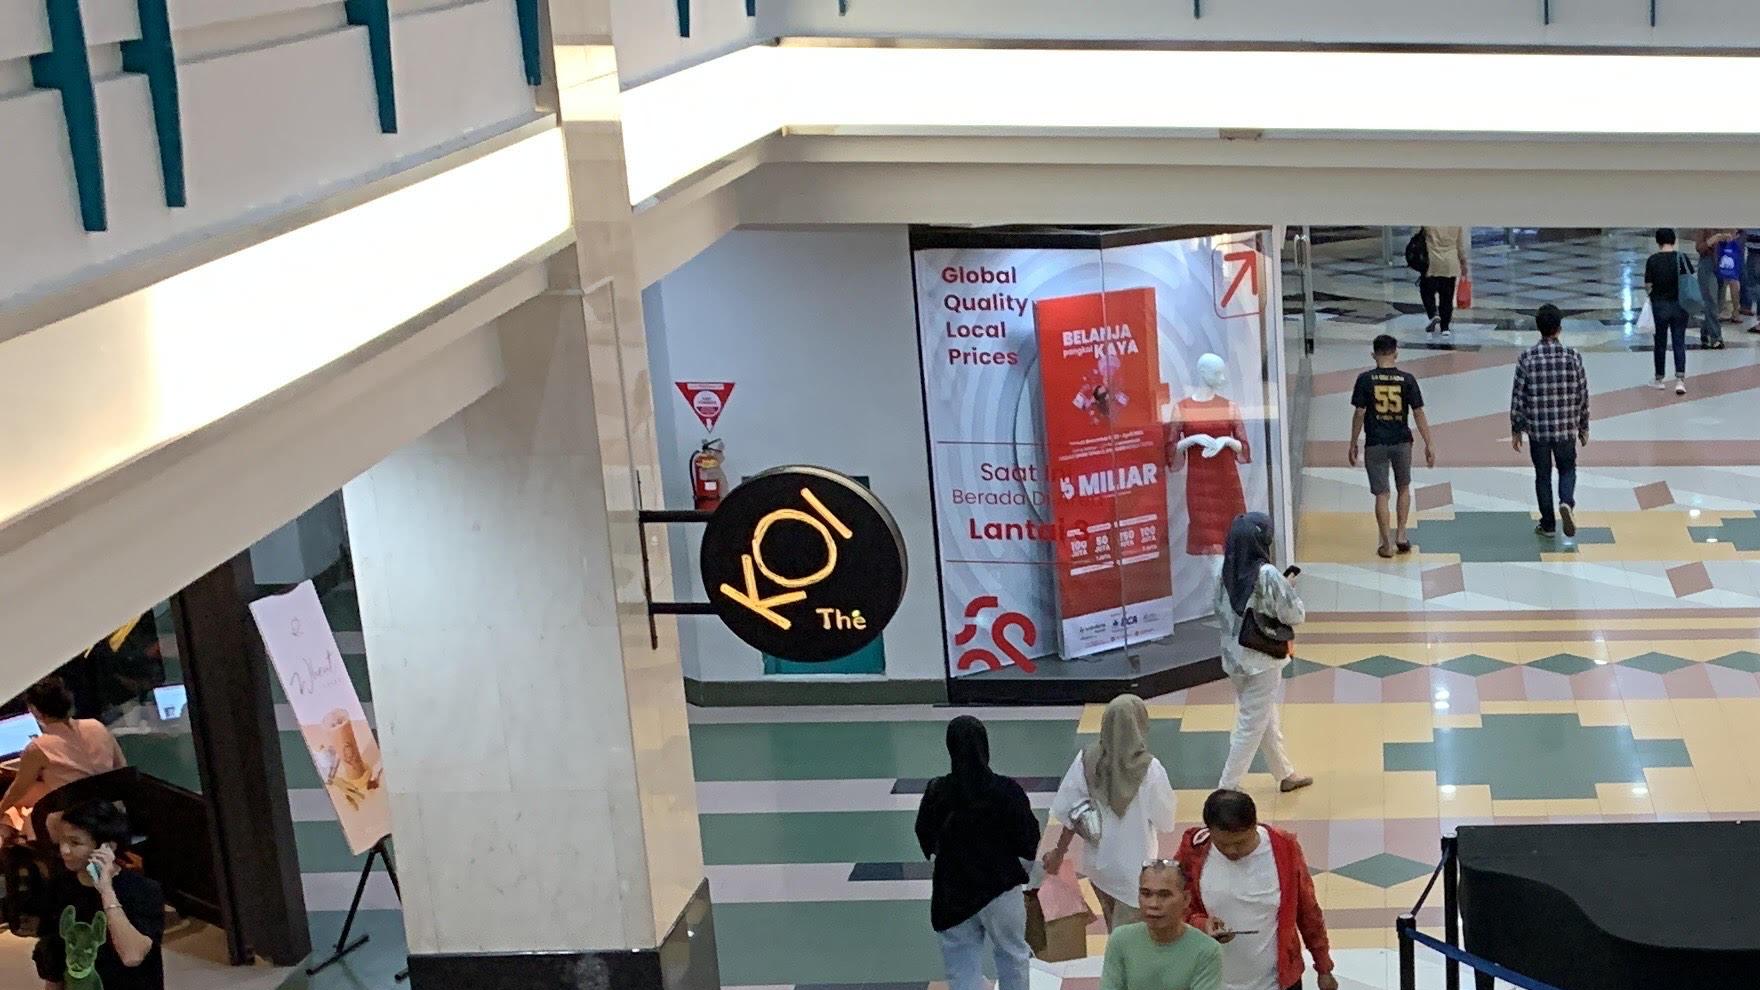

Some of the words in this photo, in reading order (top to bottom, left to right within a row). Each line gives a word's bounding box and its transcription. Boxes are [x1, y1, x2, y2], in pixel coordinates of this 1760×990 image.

[941, 266, 1016, 284] Global
[943, 293, 1028, 317] Quality
[946, 321, 1006, 338] Local
[1062, 324, 1132, 346] BELANJA
[948, 347, 1018, 365] Prices
[1094, 339, 1139, 359] KAYA
[1374, 384, 1402, 413] 55
[980, 462, 1037, 482] Saat
[1078, 462, 1157, 497] MILIAR
[952, 488, 1025, 505] Berada
[720, 487, 853, 631] KOI
